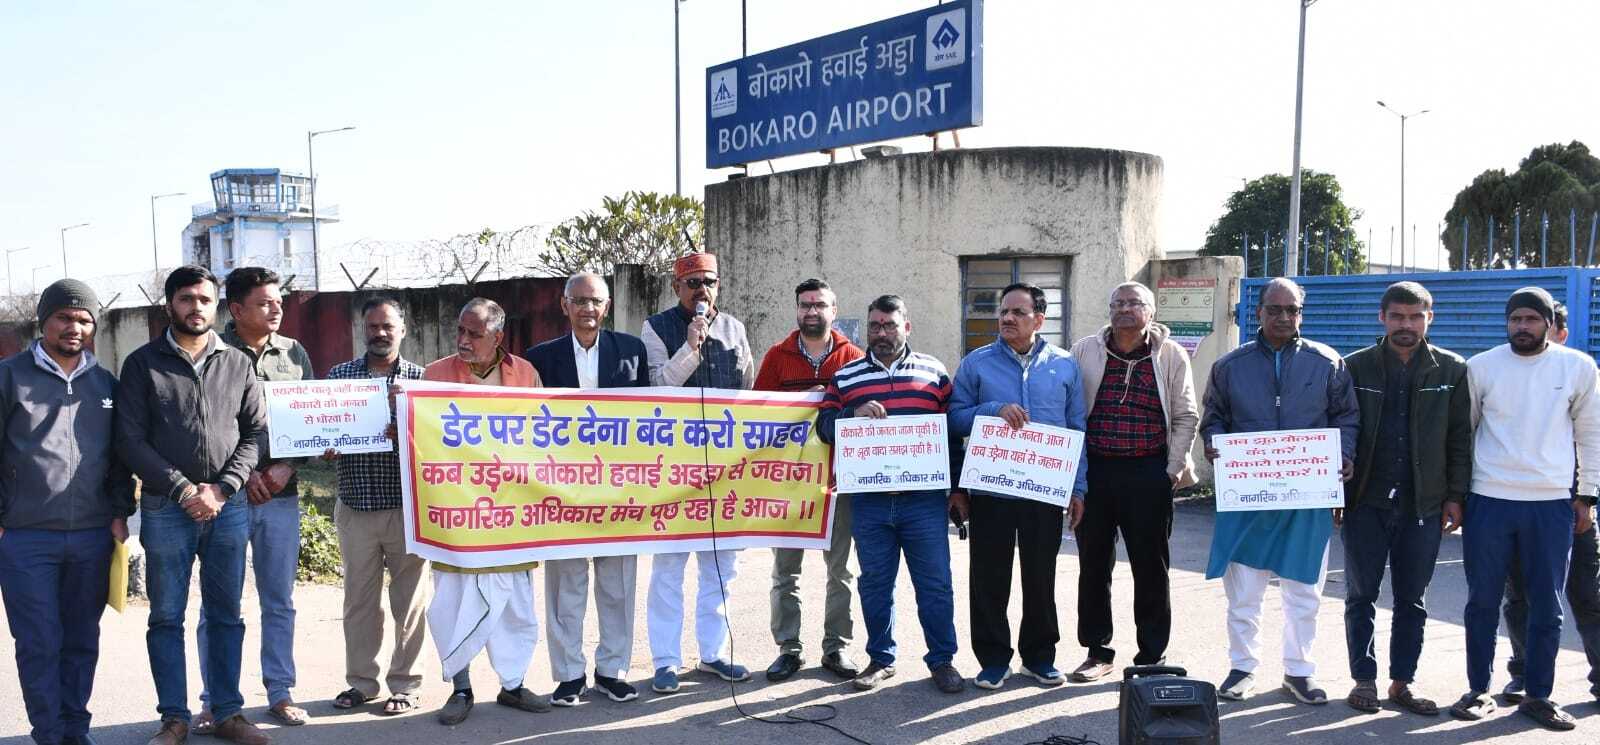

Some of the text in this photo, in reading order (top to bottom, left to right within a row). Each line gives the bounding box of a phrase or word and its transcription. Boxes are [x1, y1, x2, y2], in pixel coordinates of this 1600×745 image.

[748, 34, 917, 100] बोकारो हवाई अड्डा
[718, 83, 952, 154] BOKARO AIRPORT
[304, 415, 313, 425] से
[441, 402, 812, 450] डेट पर डेट देना बंद करो साहब
[294, 435, 330, 449] नागरिक
[333, 434, 369, 446] अधिकार
[1019, 429, 1044, 444] जनता
[1045, 434, 1064, 447] आज
[971, 445, 986, 456] कब
[1027, 451, 1036, 464] से
[1038, 455, 1062, 470] जहाज
[421, 462, 464, 485] कब
[470, 454, 529, 492] उड़ेगा
[535, 455, 604, 485] बोकारो
[610, 455, 663, 488] हवाई
[728, 458, 747, 480] से
[858, 470, 945, 485] नागरिक अधिकार मंच
[980, 474, 1067, 499] नागरिक अधिकार मंच
[1240, 490, 1278, 503] नागरिक
[427, 496, 515, 529] नागरिक
[520, 496, 608, 527] अधिकार
[610, 497, 646, 522] मंच
[651, 501, 681, 530] पूछ
[684, 497, 717, 521] रहा
[721, 490, 738, 520] है
[742, 498, 790, 519] आज
